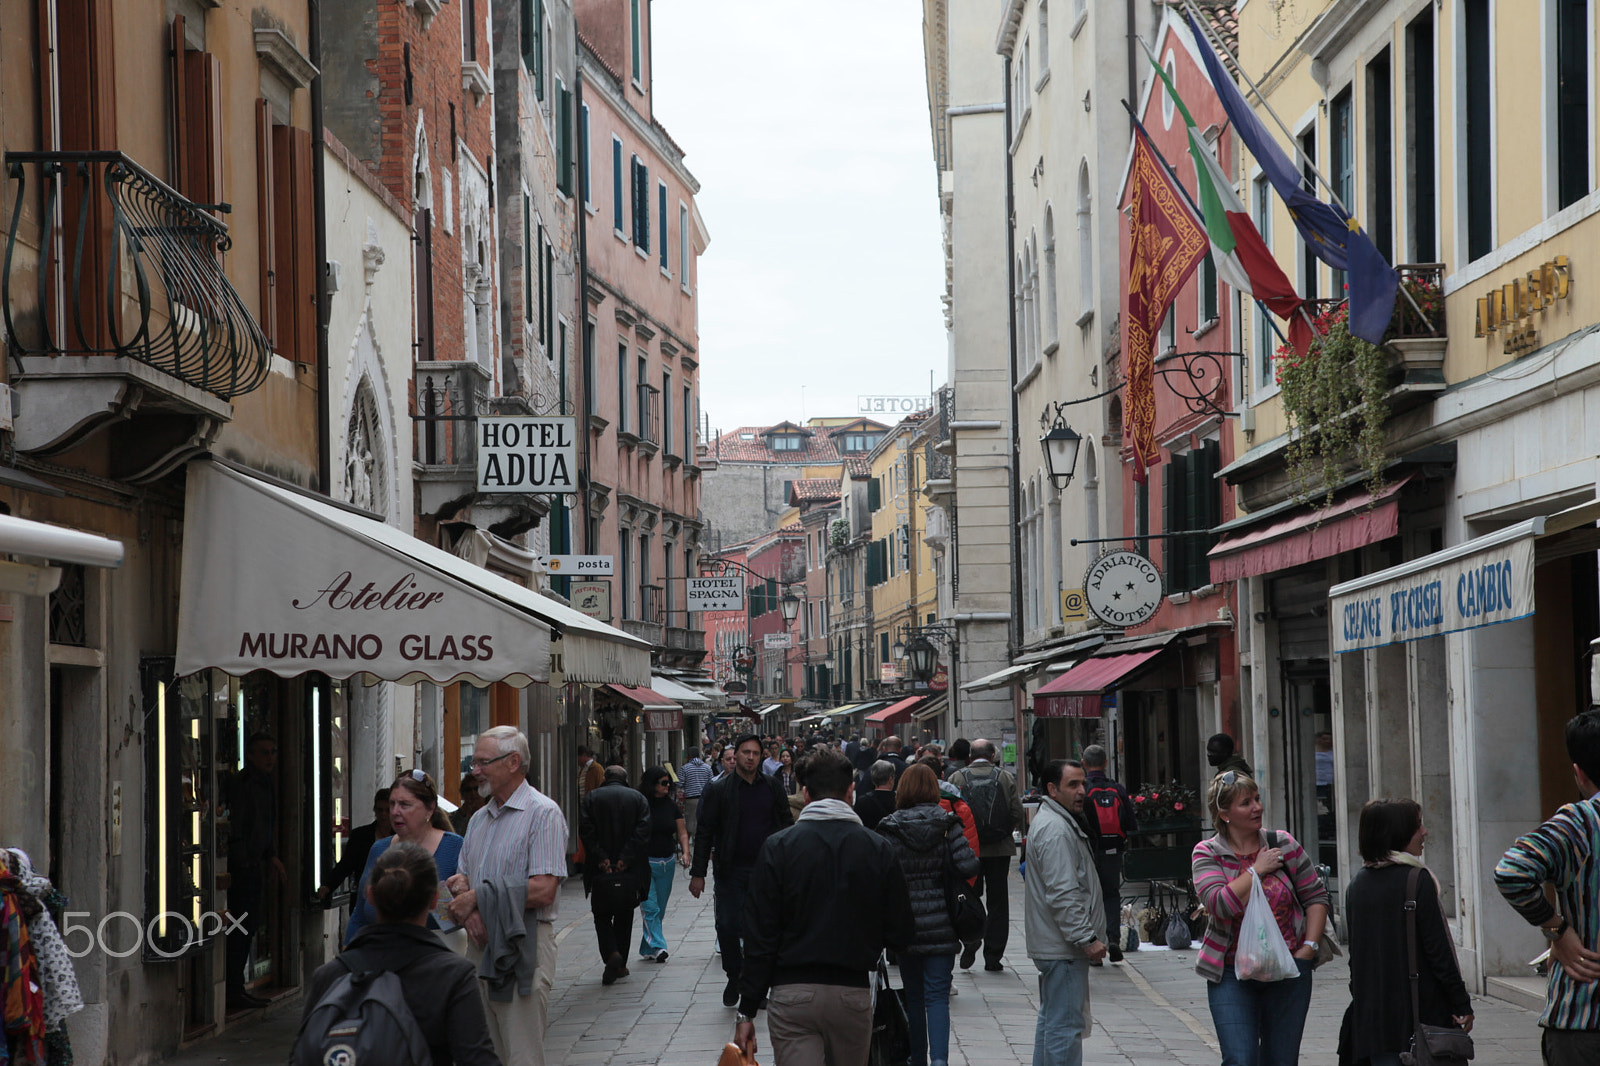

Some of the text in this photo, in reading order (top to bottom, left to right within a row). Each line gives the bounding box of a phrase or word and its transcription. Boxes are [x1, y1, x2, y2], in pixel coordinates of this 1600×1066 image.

[481, 423, 571, 447] HOTEL
[482, 453, 571, 486] ADUA
[578, 560, 610, 569] posta
[1092, 555, 1156, 590] ADRIATICO
[292, 570, 443, 611] Atelier
[689, 590, 739, 598] SPAGNA
[692, 579, 736, 588] HOTEL
[1065, 593, 1083, 611] @
[1101, 601, 1155, 622] HOTEL
[1343, 597, 1381, 641] CHANGE
[1457, 559, 1512, 618] CAMBIO
[238, 632, 494, 661] MURANO GLASS
